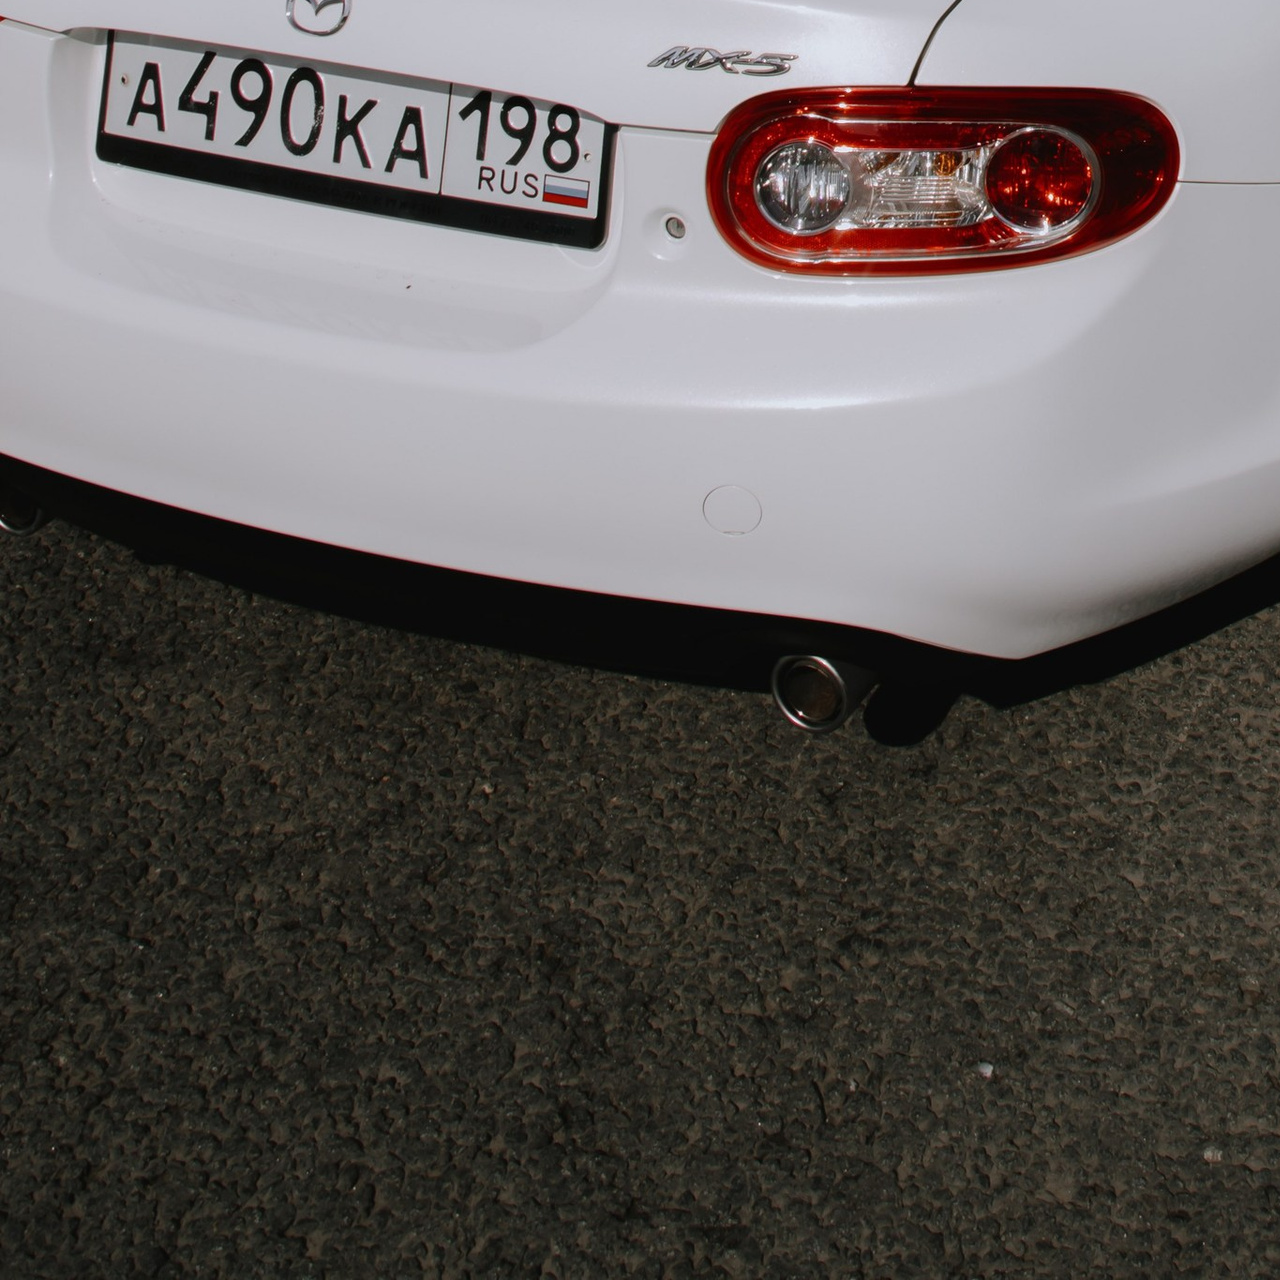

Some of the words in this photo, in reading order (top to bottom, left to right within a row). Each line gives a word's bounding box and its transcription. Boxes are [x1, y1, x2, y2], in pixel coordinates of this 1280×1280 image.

[647, 46, 799, 77] MX-5
[458, 90, 580, 174] 198
[478, 166, 539, 199] RUS
